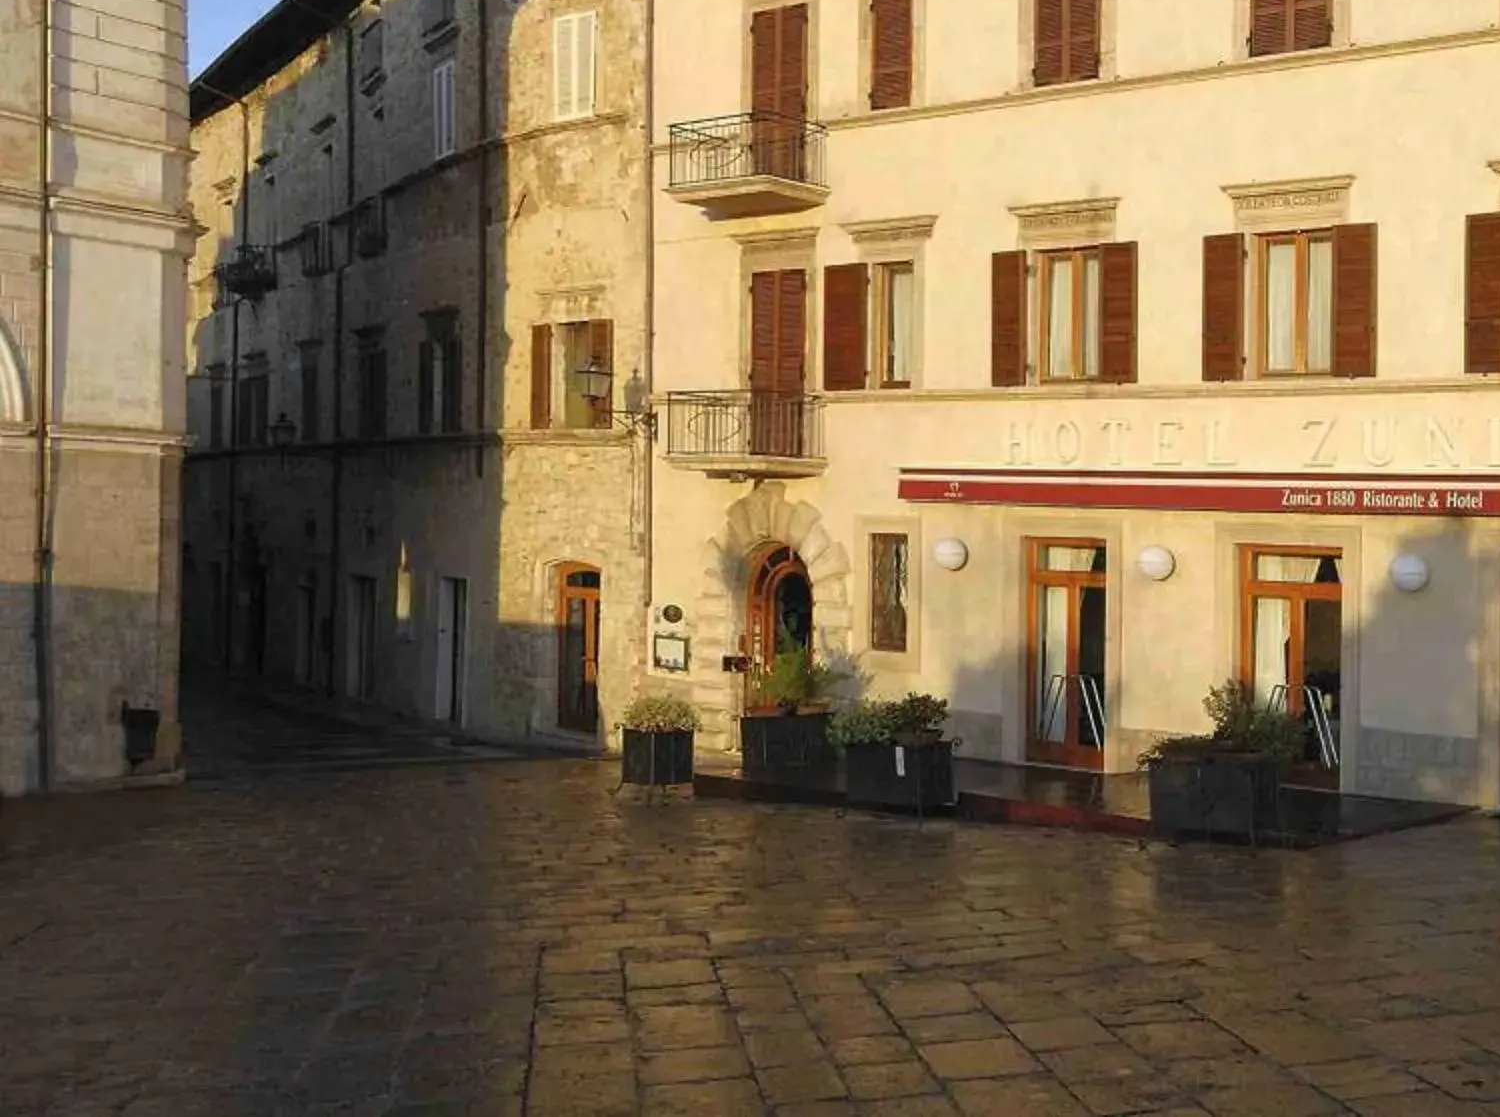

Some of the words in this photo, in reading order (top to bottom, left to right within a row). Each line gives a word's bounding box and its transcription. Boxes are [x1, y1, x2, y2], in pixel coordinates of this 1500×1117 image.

[1002, 418, 1240, 467] HOTEL
[1281, 488, 1322, 506] Zunica
[1326, 489, 1356, 507] 1880
[1363, 489, 1425, 508] Ristorante
[1427, 491, 1438, 508] &
[1446, 490, 1484, 509] Hotel
